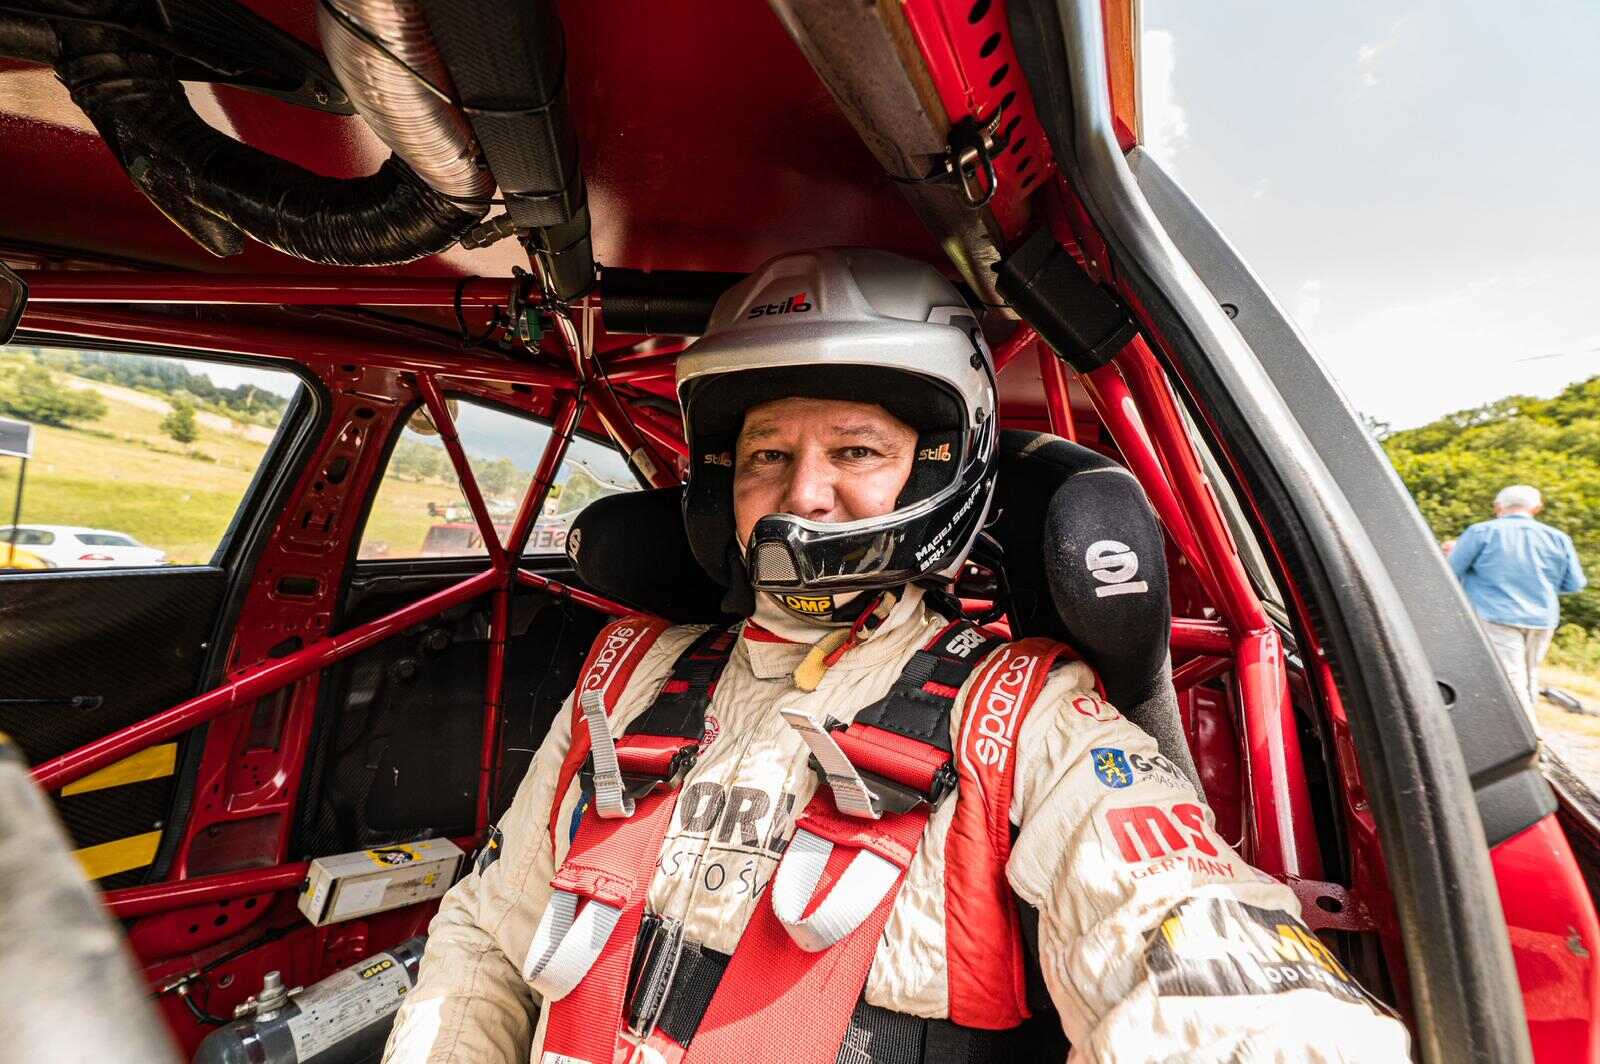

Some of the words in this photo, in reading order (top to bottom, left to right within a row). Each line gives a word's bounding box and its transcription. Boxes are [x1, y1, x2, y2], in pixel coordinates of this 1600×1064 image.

[748, 292, 812, 320] stilo
[917, 443, 952, 461] stilo
[786, 596, 831, 613] OMP
[584, 627, 635, 691] sparc
[975, 655, 1030, 766] sparco
[363, 960, 393, 979] OMP
